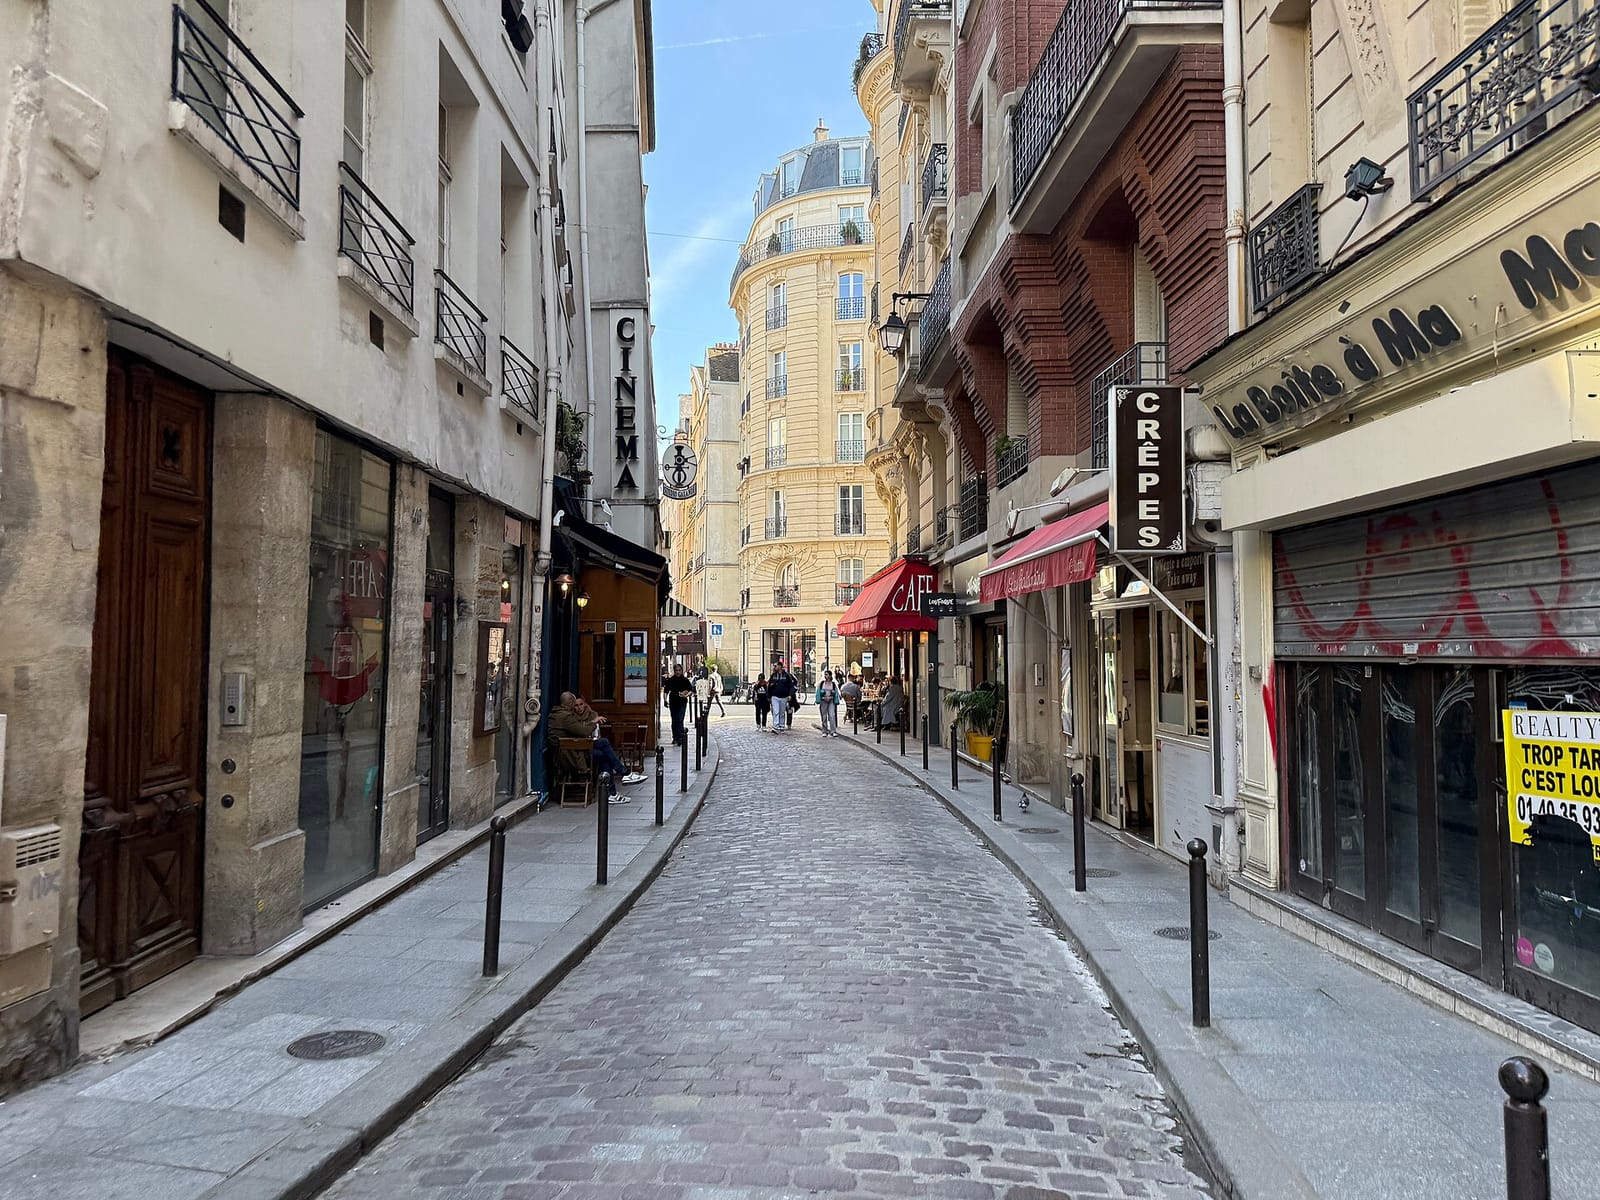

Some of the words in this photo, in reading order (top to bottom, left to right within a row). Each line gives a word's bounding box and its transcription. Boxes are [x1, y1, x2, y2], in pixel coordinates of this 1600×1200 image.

[614, 316, 639, 489] CINEMA
[1213, 400, 1260, 438] La
[1338, 335, 1381, 382] à
[1371, 303, 1463, 367] Ma
[1136, 392, 1161, 548] CRÊPES
[1514, 715, 1600, 740] REALTY
[1521, 743, 1563, 767] TROP
[1521, 769, 1565, 793] C'EST
